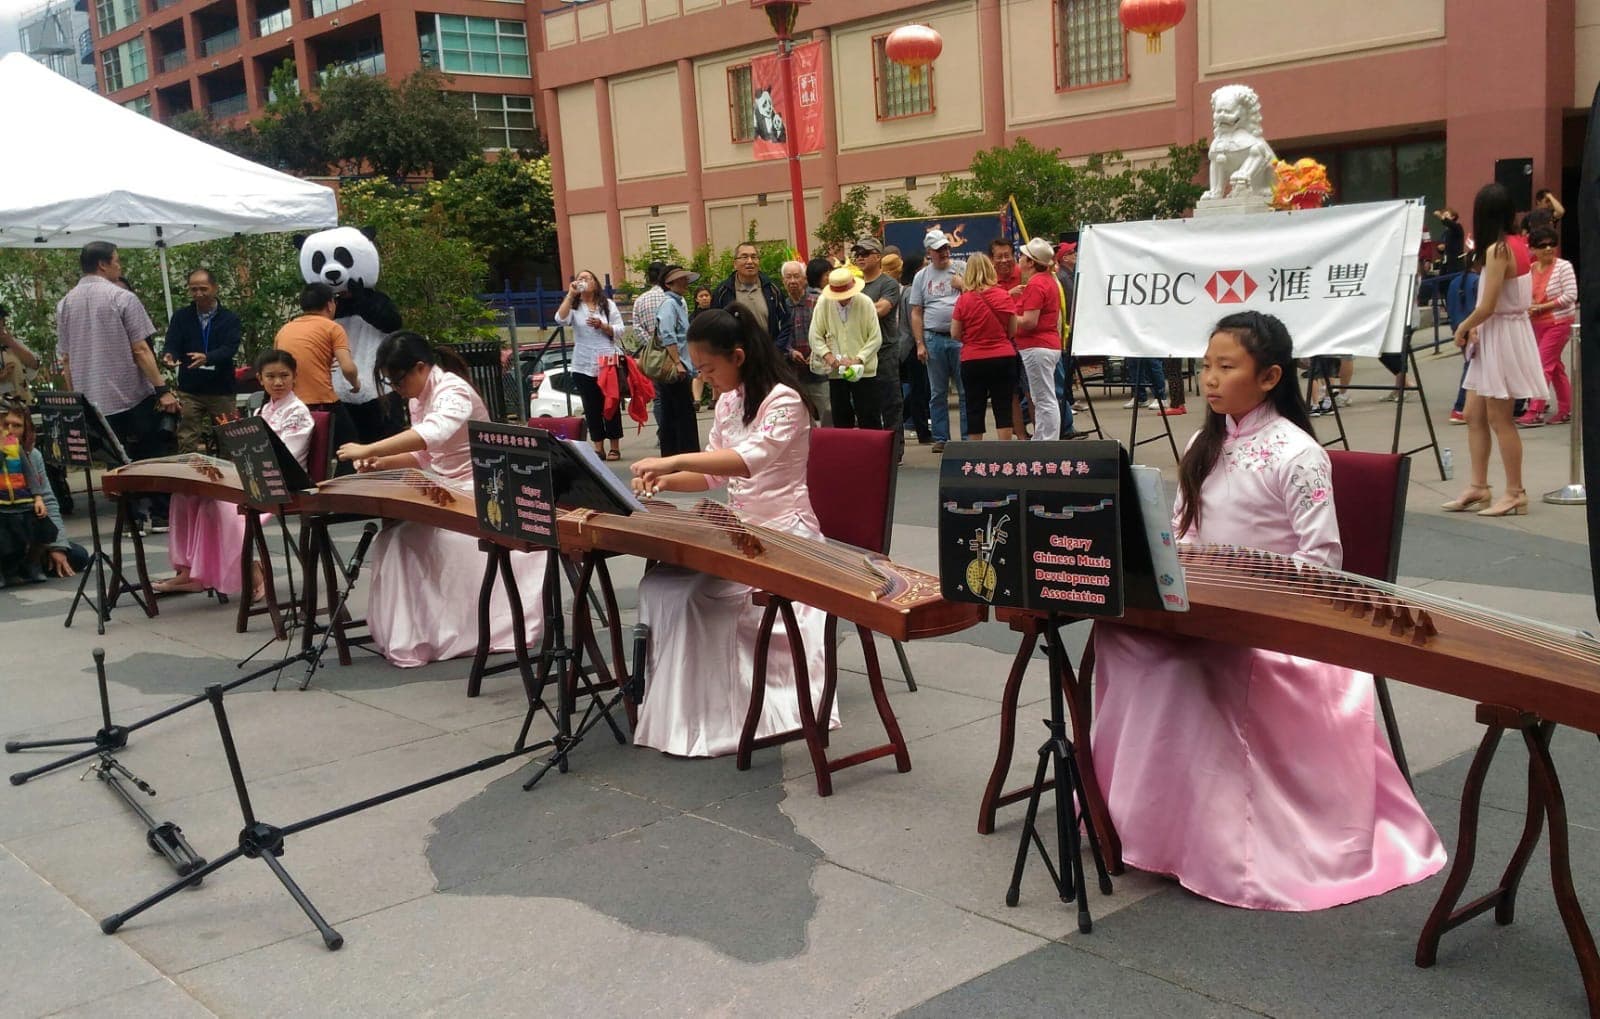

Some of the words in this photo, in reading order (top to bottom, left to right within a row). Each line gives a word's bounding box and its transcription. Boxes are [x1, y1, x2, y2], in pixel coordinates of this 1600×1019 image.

[1105, 271, 1196, 306] HSBC
[1050, 535, 1092, 550] Calgary
[1033, 552, 1075, 565] Chinese
[1077, 554, 1111, 568] Music
[1035, 569, 1110, 586] Development
[1040, 586, 1105, 604] Association
